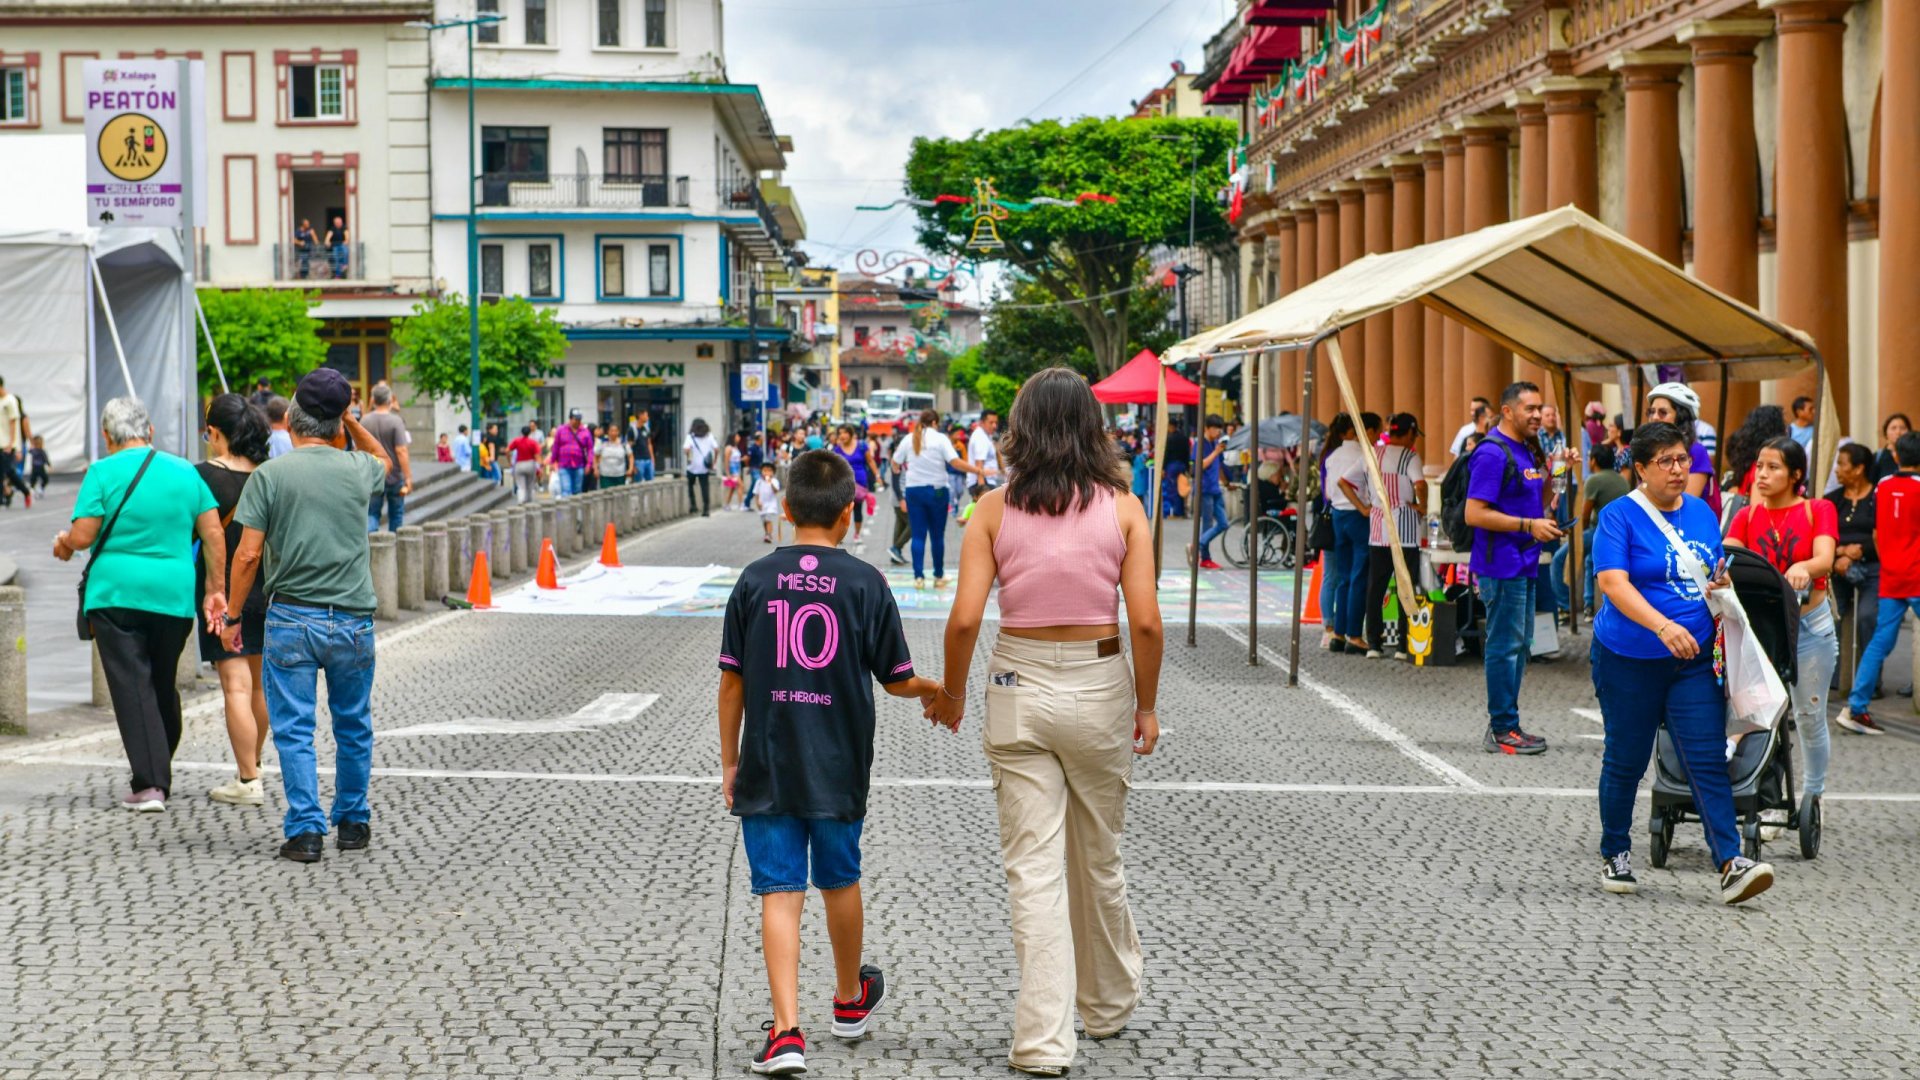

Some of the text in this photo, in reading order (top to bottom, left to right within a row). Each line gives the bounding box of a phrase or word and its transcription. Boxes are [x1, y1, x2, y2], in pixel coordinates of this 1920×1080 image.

[120, 71, 156, 81] Xalapa
[88, 84, 176, 110] PEATÓN
[95, 197, 110, 207] TU
[597, 363, 684, 377] DEVLYN
[777, 572, 837, 594] MESSI
[767, 599, 839, 670] 10
[770, 690, 832, 705] THE HERONS
